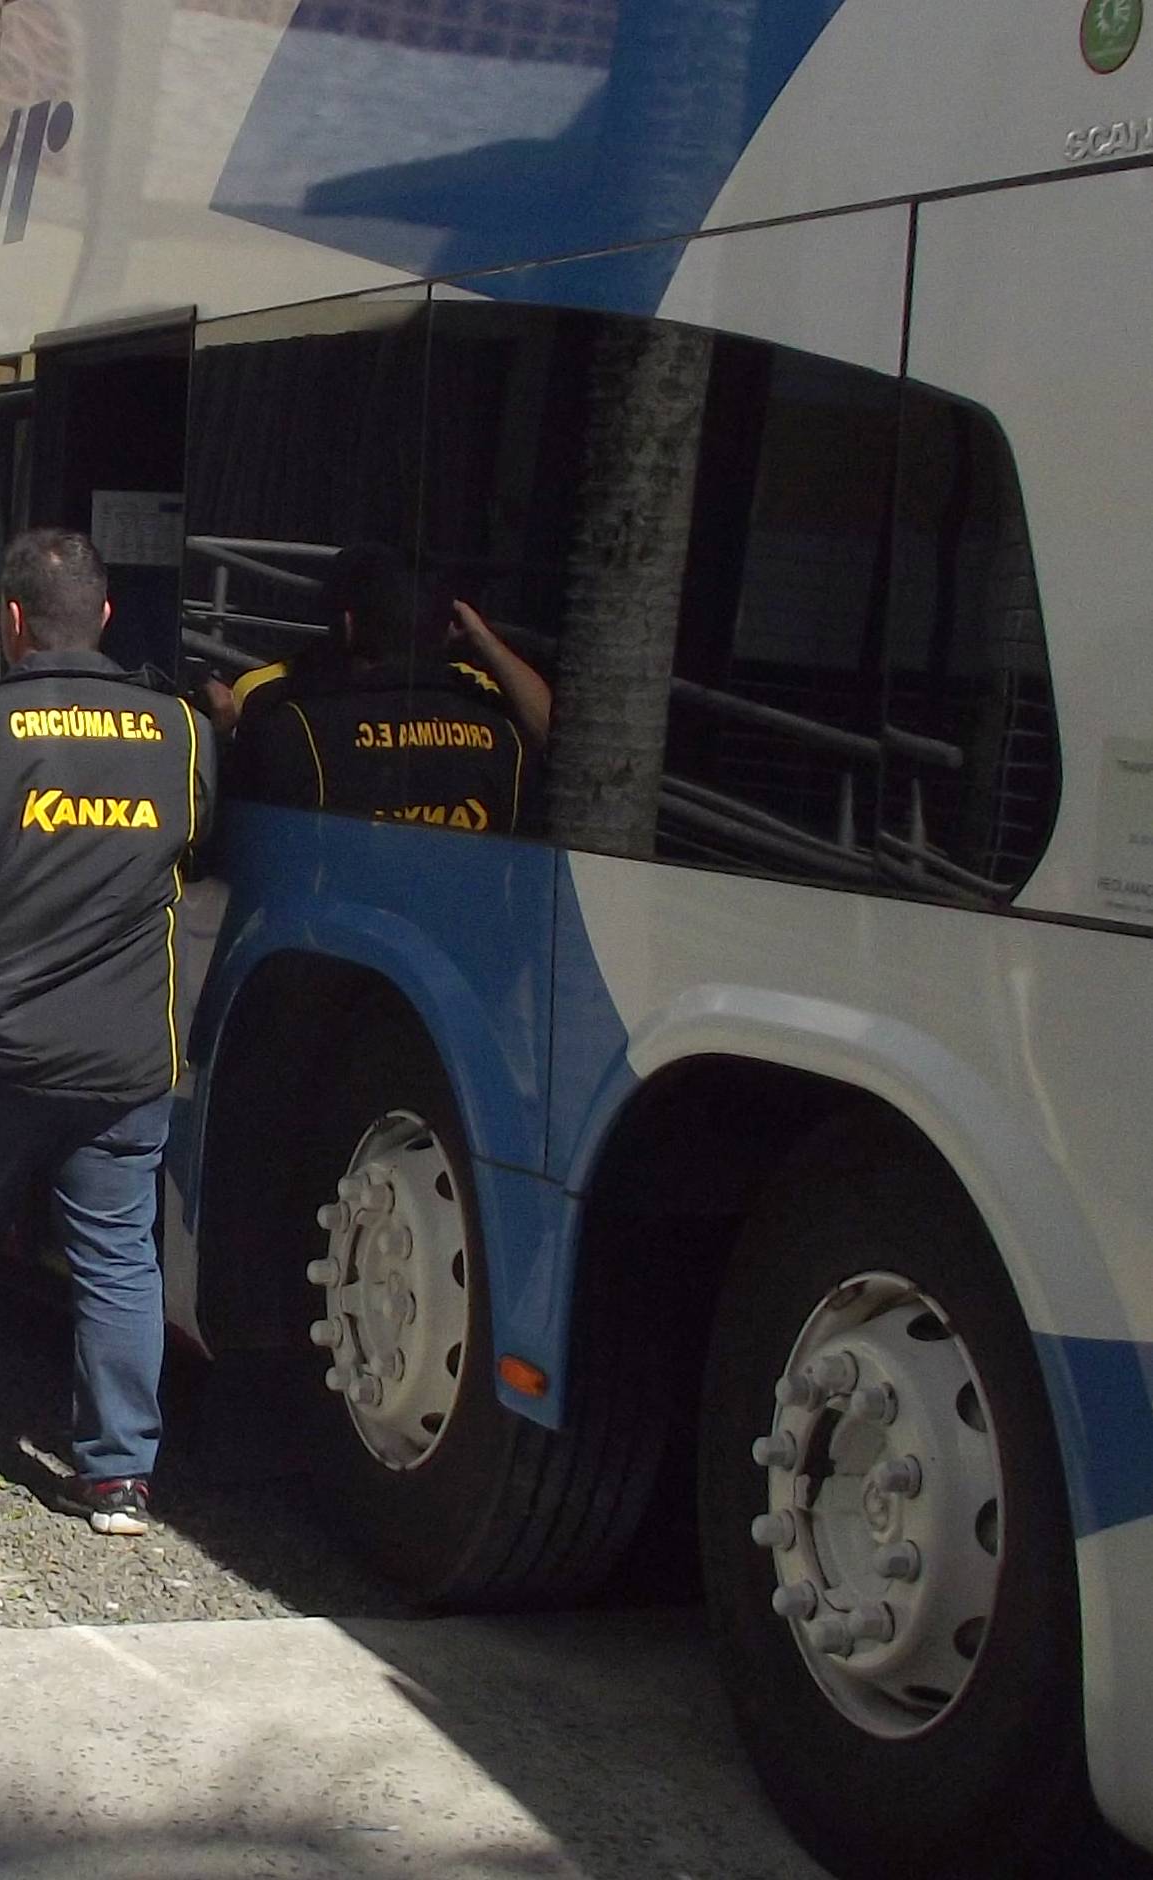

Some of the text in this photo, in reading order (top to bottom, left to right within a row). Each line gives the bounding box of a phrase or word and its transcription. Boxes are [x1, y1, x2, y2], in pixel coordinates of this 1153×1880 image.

[10, 704, 163, 740] CRICIÚMA E.C.
[22, 789, 159, 832] KANXA
